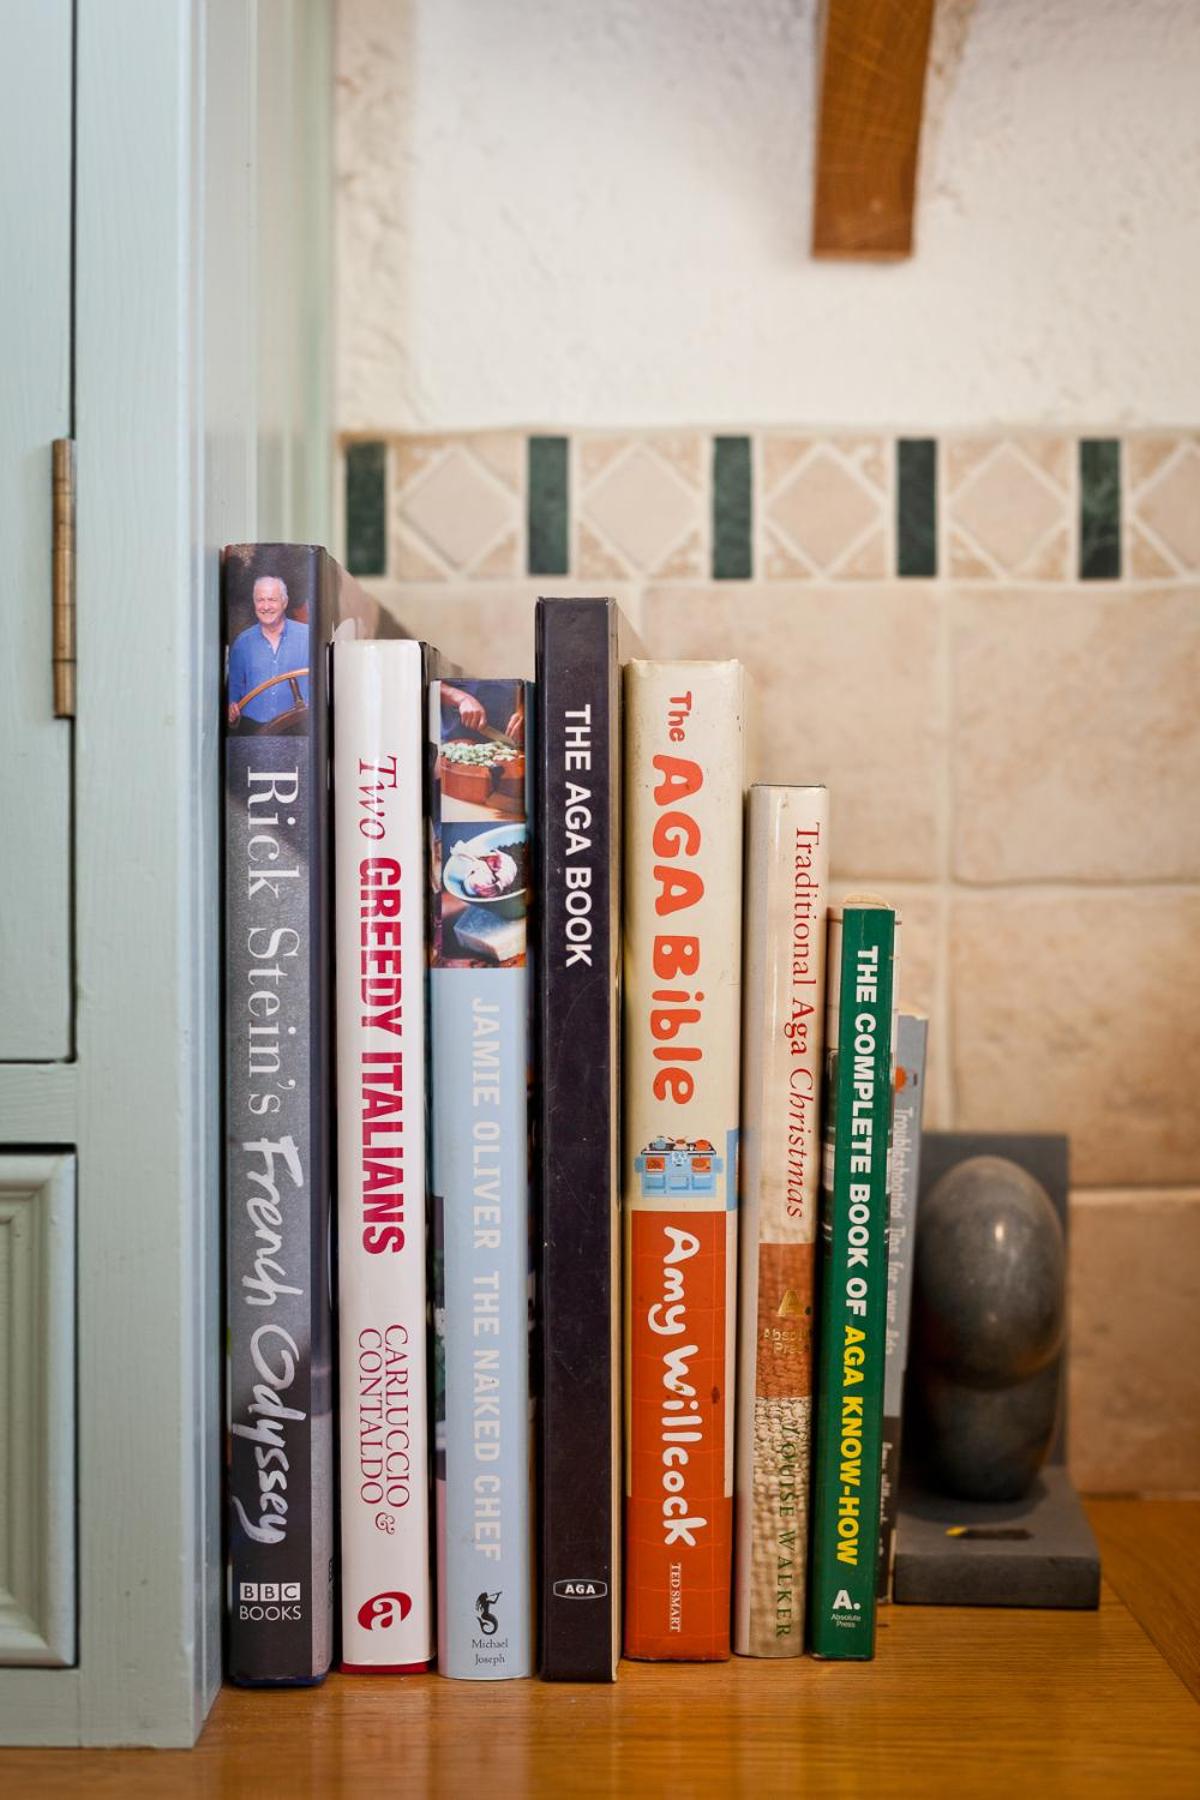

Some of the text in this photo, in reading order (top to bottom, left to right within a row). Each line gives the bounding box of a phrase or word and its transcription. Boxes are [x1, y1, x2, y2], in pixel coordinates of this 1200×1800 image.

[564, 704, 593, 967] THE AGA BOOK
[650, 691, 704, 1105] The AGA Bible
[357, 755, 406, 1255] Two GREEDY ITALIANS
[784, 822, 821, 1219] Traditional Aga Christmas
[232, 766, 306, 1544] Rick Stein's French Odyssey
[837, 945, 879, 1566] THE COMPLETE BOOK OF AGA KNOW-HOW
[472, 997, 501, 1562] JAMIE OLIVER THE NAKED CHEF
[358, 1327, 384, 1505] CONTALDO
[383, 1323, 410, 1509] CARLUCCIO
[647, 1226, 707, 1547] Amy Willcock
[240, 1605, 302, 1621] BOOKS
[241, 1583, 300, 1600] BBC
[374, 1511, 395, 1535] &
[564, 1583, 596, 1595] AGA
[671, 1562, 683, 1633] TED SMART
[776, 1423, 804, 1640] LOUISE WALKER
[471, 1638, 508, 1650] Michael
[475, 1653, 506, 1665] Joseph
